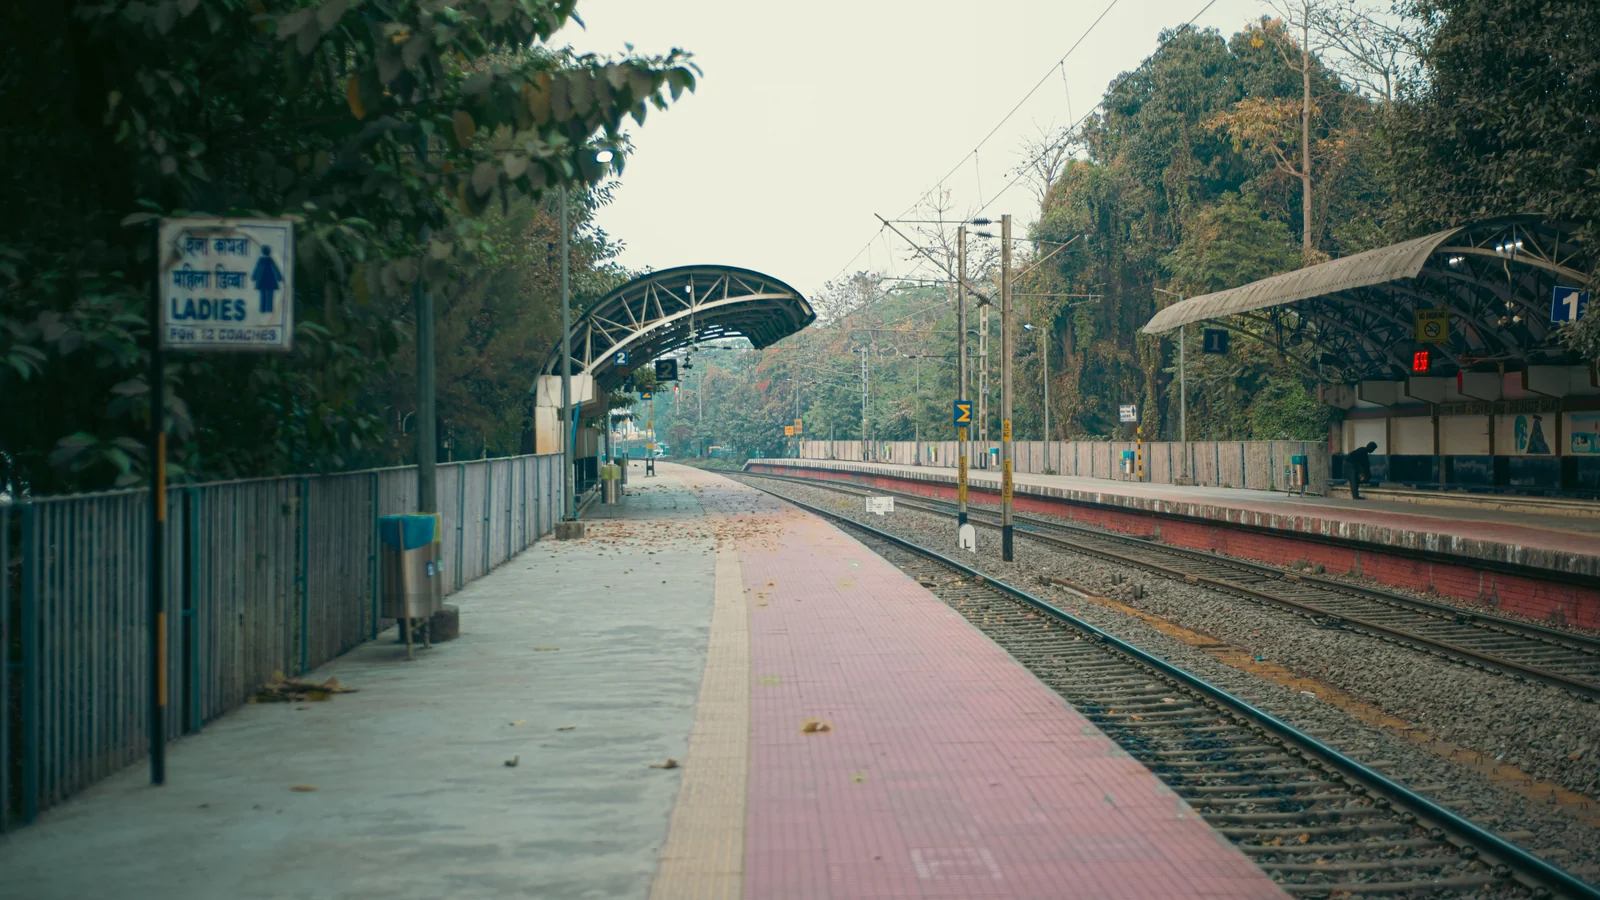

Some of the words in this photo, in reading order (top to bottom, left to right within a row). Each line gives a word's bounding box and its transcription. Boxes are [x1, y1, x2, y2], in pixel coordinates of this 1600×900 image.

[172, 262, 211, 291] महिला
[171, 297, 246, 321] LADIES
[1562, 292, 1579, 323] 1
[170, 328, 195, 340] FOR
[201, 328, 214, 340] 12
[218, 328, 276, 341] COACHES
[1209, 333, 1220, 351] 1
[616, 352, 625, 364] 2
[658, 362, 673, 378] 2
[964, 538, 971, 549] L
